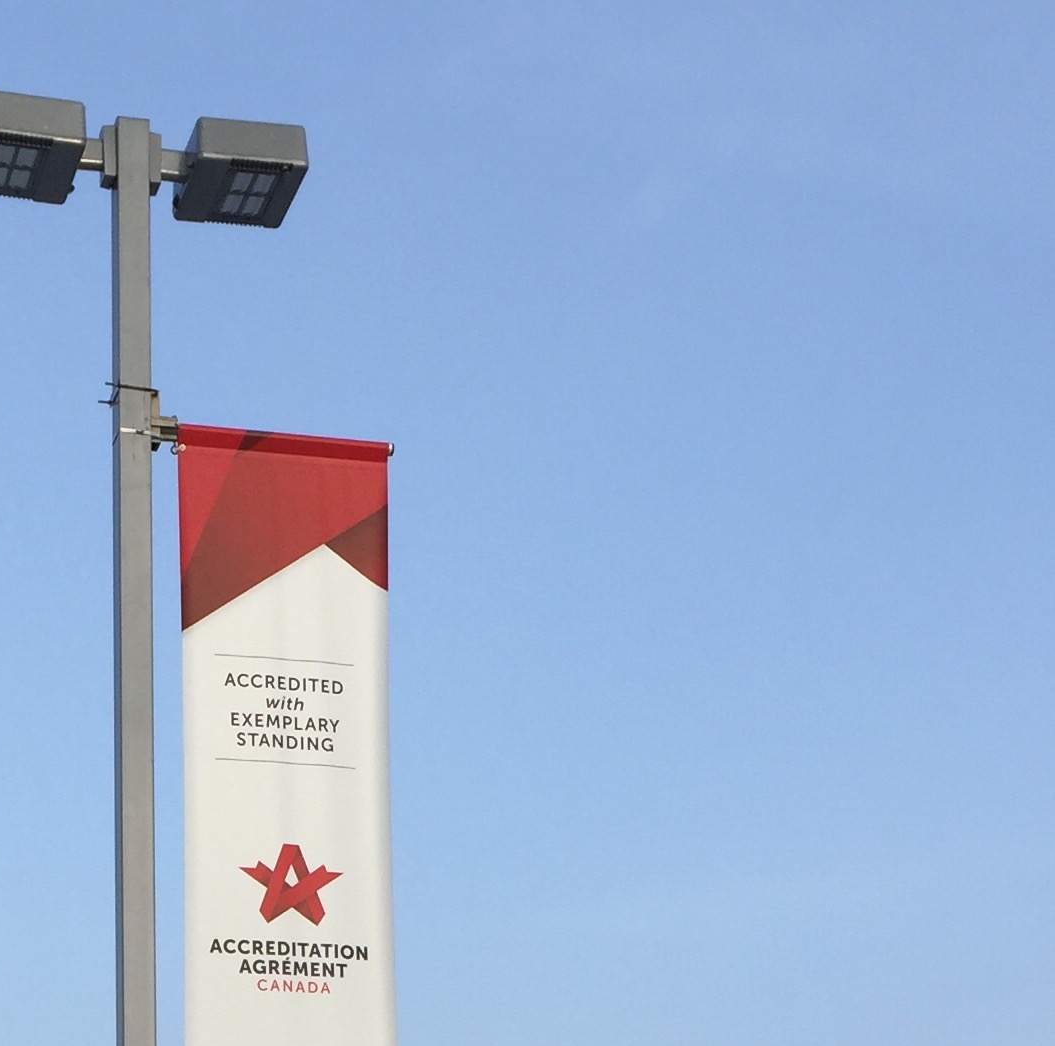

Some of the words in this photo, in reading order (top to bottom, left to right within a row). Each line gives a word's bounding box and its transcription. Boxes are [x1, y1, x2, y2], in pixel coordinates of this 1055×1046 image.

[224, 672, 344, 695] ACCREDITED
[265, 695, 305, 712] with
[230, 712, 340, 733] EXEMPLARY
[236, 732, 335, 752] STANDING
[209, 938, 369, 961] ACCREDITATION
[238, 956, 348, 978] AGRÉMENT
[257, 979, 331, 994] CANADA
